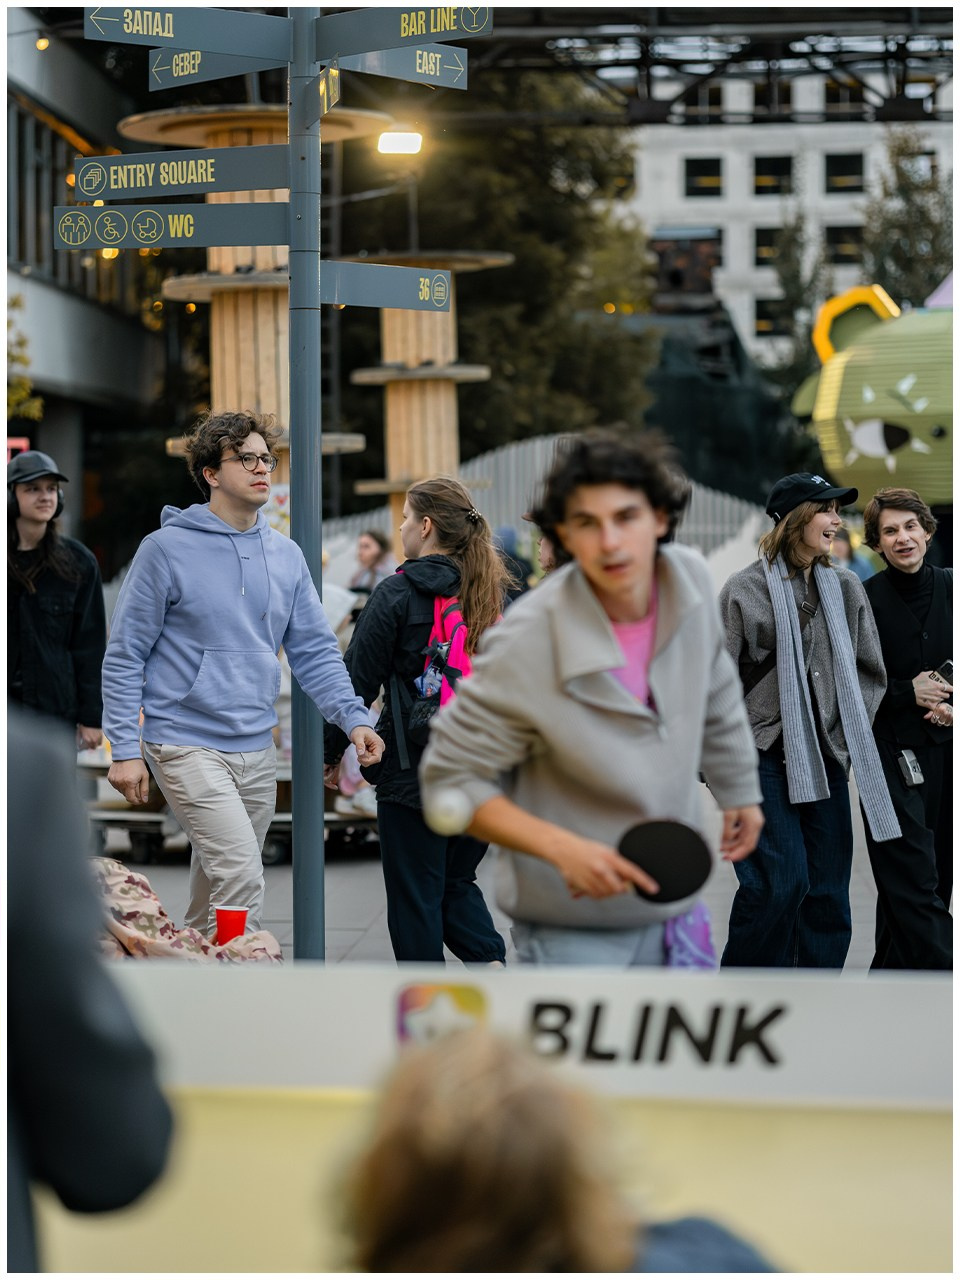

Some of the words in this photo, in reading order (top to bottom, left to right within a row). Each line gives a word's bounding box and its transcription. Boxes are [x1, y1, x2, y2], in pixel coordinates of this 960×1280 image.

[123, 8, 174, 38] ЗАПАД
[400, 10, 426, 38] BAR
[430, 6, 458, 33] LINE
[172, 50, 202, 77] СЕВЕР
[416, 50, 442, 76] EAST
[110, 163, 156, 190] ENTRY
[159, 159, 215, 186] SQUARE
[168, 213, 195, 238] WC
[419, 277, 430, 301] 36
[530, 1001, 786, 1066] BLINK
